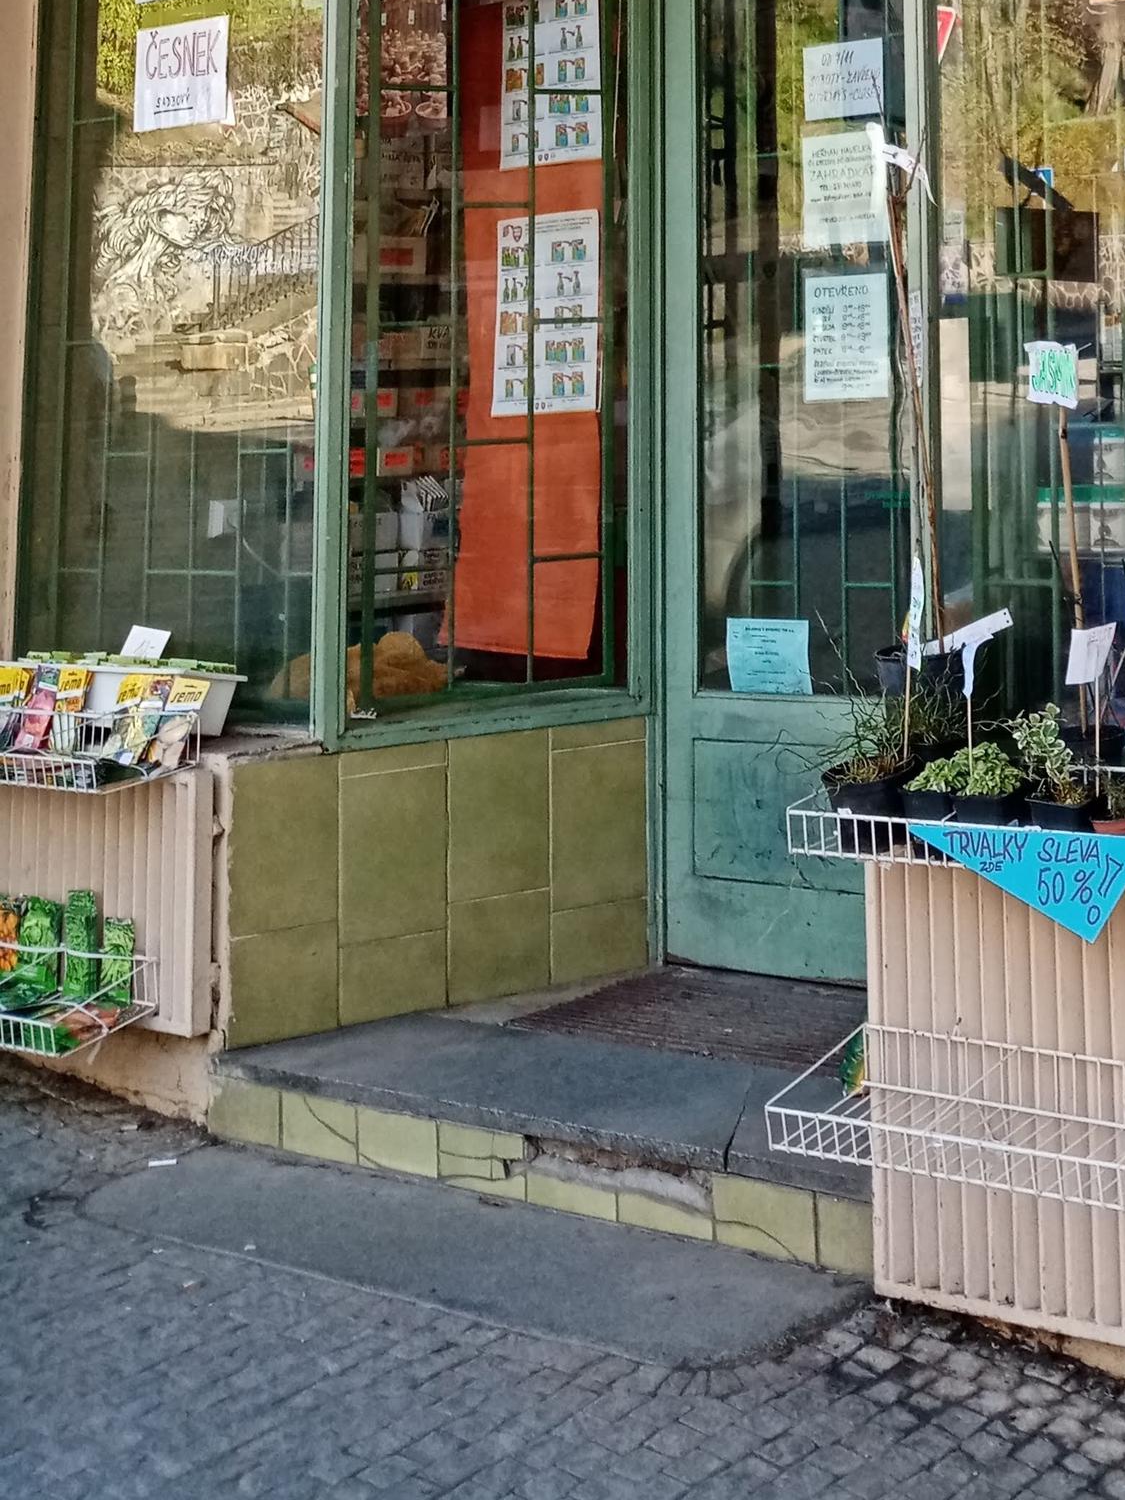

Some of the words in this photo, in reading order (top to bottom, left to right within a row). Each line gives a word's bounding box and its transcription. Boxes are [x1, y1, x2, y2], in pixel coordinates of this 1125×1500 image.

[145, 30, 221, 80] ČESNEK
[814, 284, 869, 299] OTEVŘENO
[942, 830, 1029, 865] TRVALKY
[1037, 837, 1102, 869] SLEVA
[979, 860, 1004, 873] ZDE
